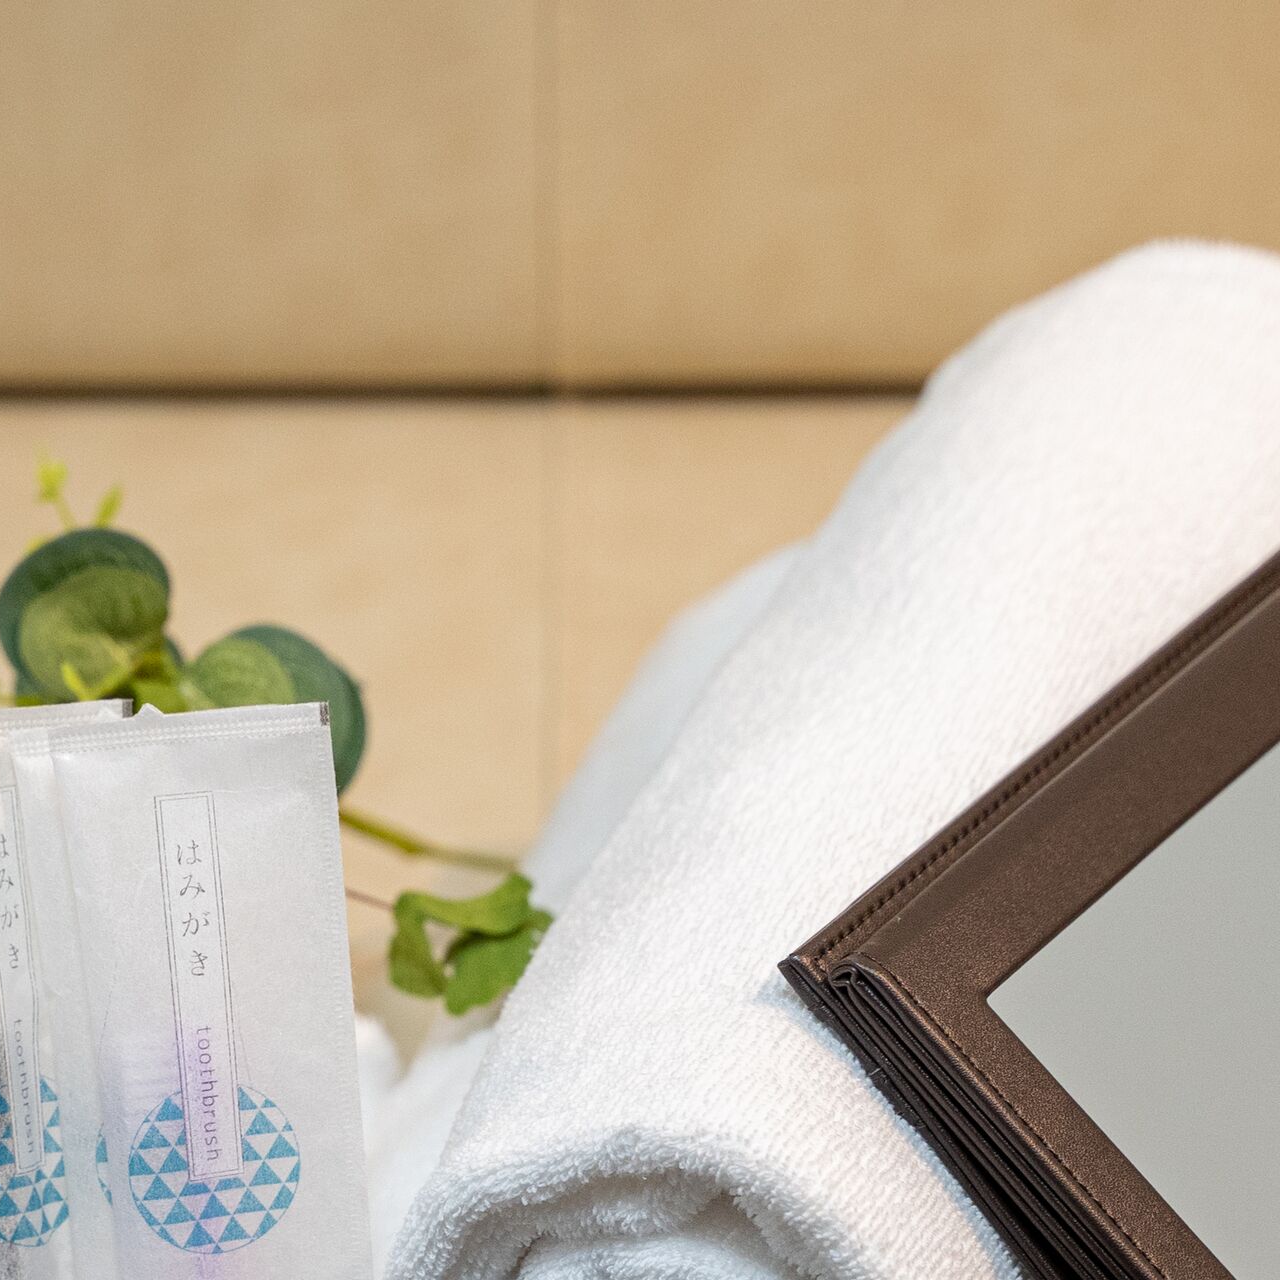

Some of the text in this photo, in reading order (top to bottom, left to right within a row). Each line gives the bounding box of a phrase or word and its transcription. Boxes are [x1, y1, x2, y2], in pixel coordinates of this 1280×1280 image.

[176, 839, 211, 977] はみがき
[196, 1025, 224, 1162] toothbrush
